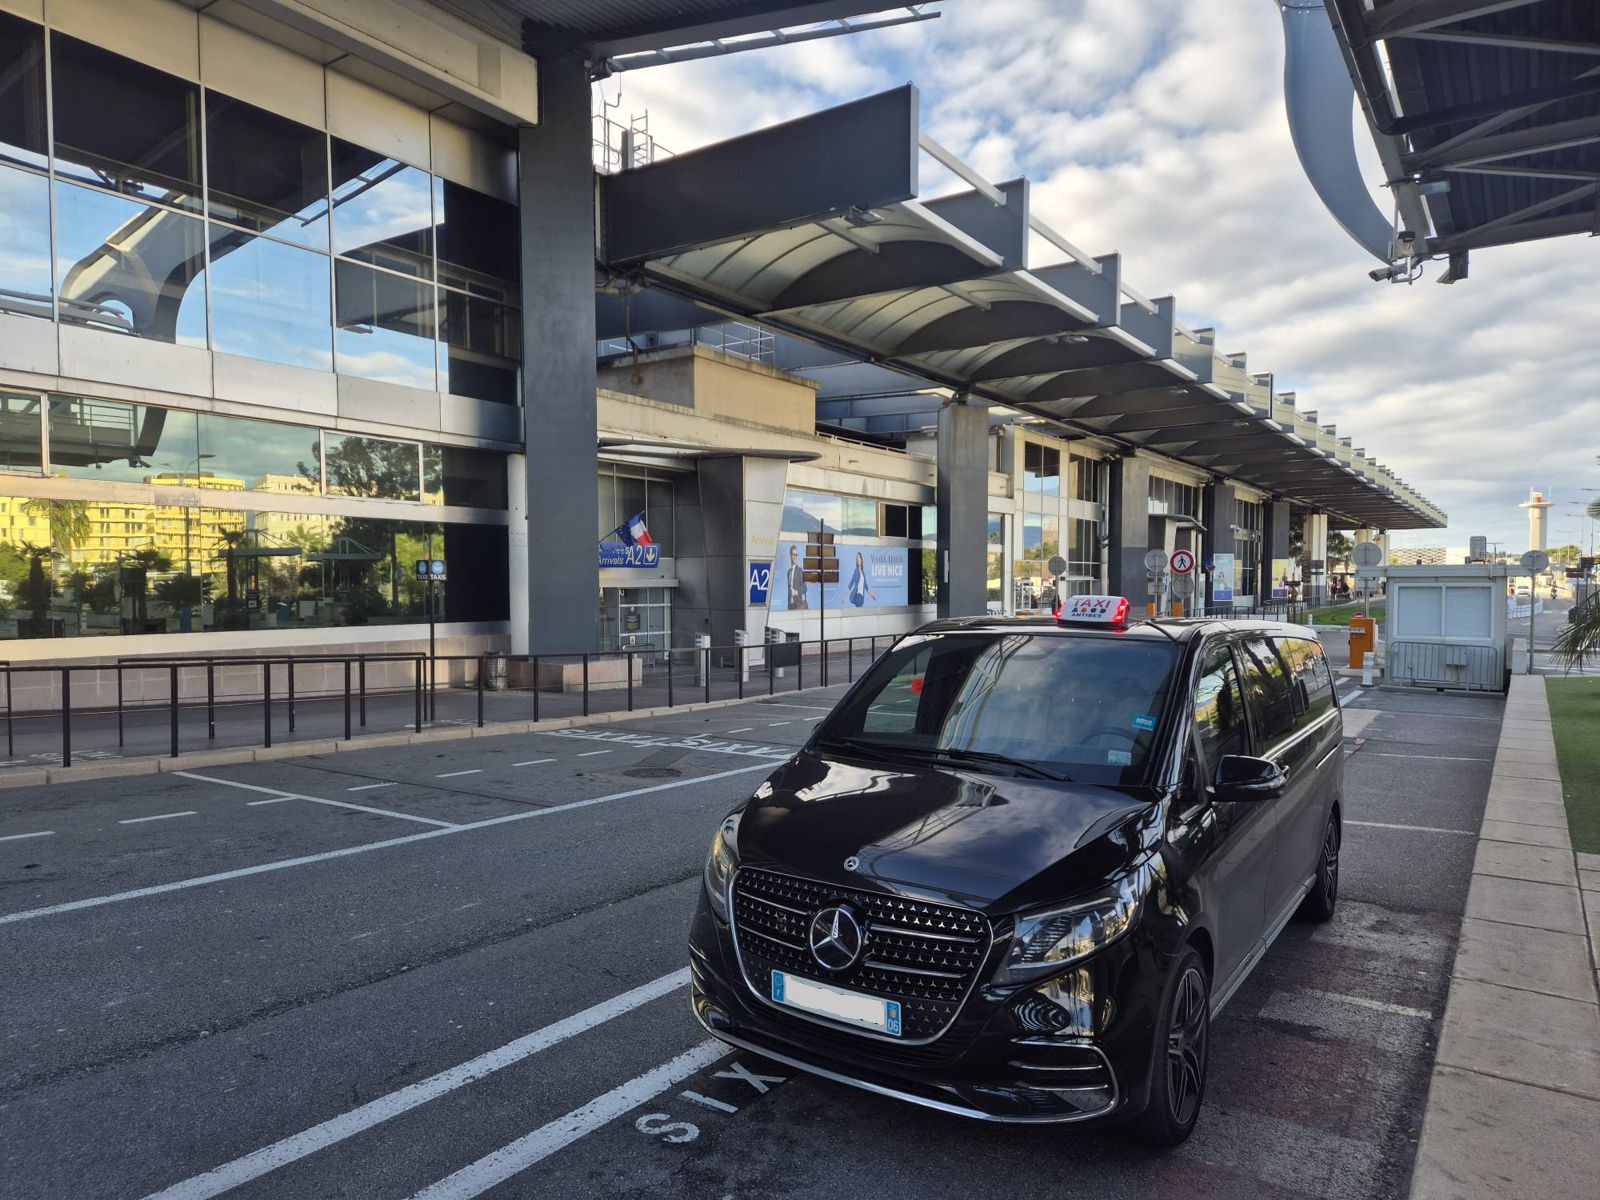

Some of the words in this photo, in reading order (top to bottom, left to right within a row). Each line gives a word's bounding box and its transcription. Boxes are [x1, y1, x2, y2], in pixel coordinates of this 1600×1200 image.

[625, 544, 643, 565] A2
[872, 564, 887, 576] LIVE
[888, 564, 904, 576] NICE
[749, 568, 770, 591] A2
[1074, 599, 1112, 608] TAXI
[887, 1018, 899, 1033] 06
